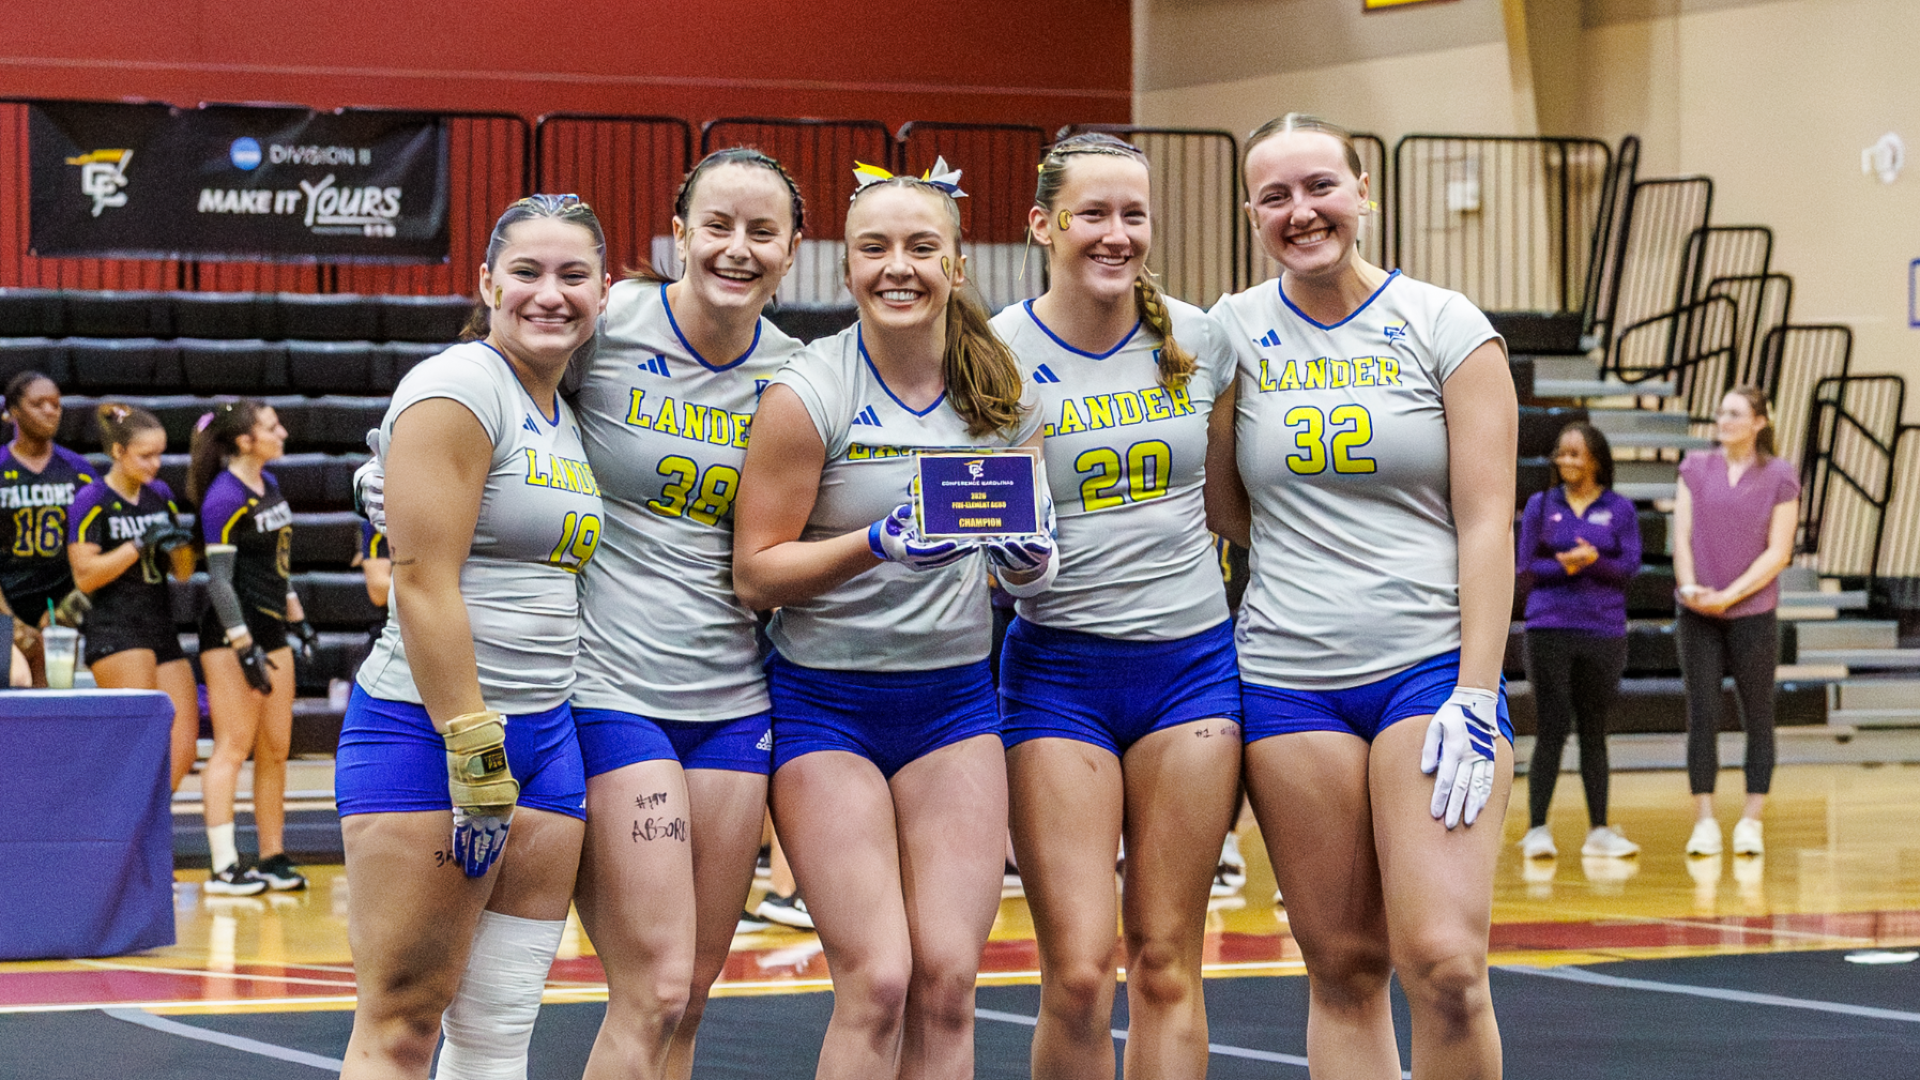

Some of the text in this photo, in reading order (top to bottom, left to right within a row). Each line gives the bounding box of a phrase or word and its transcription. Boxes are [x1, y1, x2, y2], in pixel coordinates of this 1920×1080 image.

[198, 173, 402, 227] MAKE IT YOURS
[1259, 356, 1403, 393] LANDER
[625, 386, 752, 450] LANDE
[1284, 403, 1377, 475] 32
[0, 483, 75, 508] FALCONS
[648, 454, 741, 527] 38
[1073, 438, 1173, 512] 20
[12, 506, 66, 557] 16
[549, 510, 601, 574] 19
[959, 518, 1002, 528] CHAMPION
